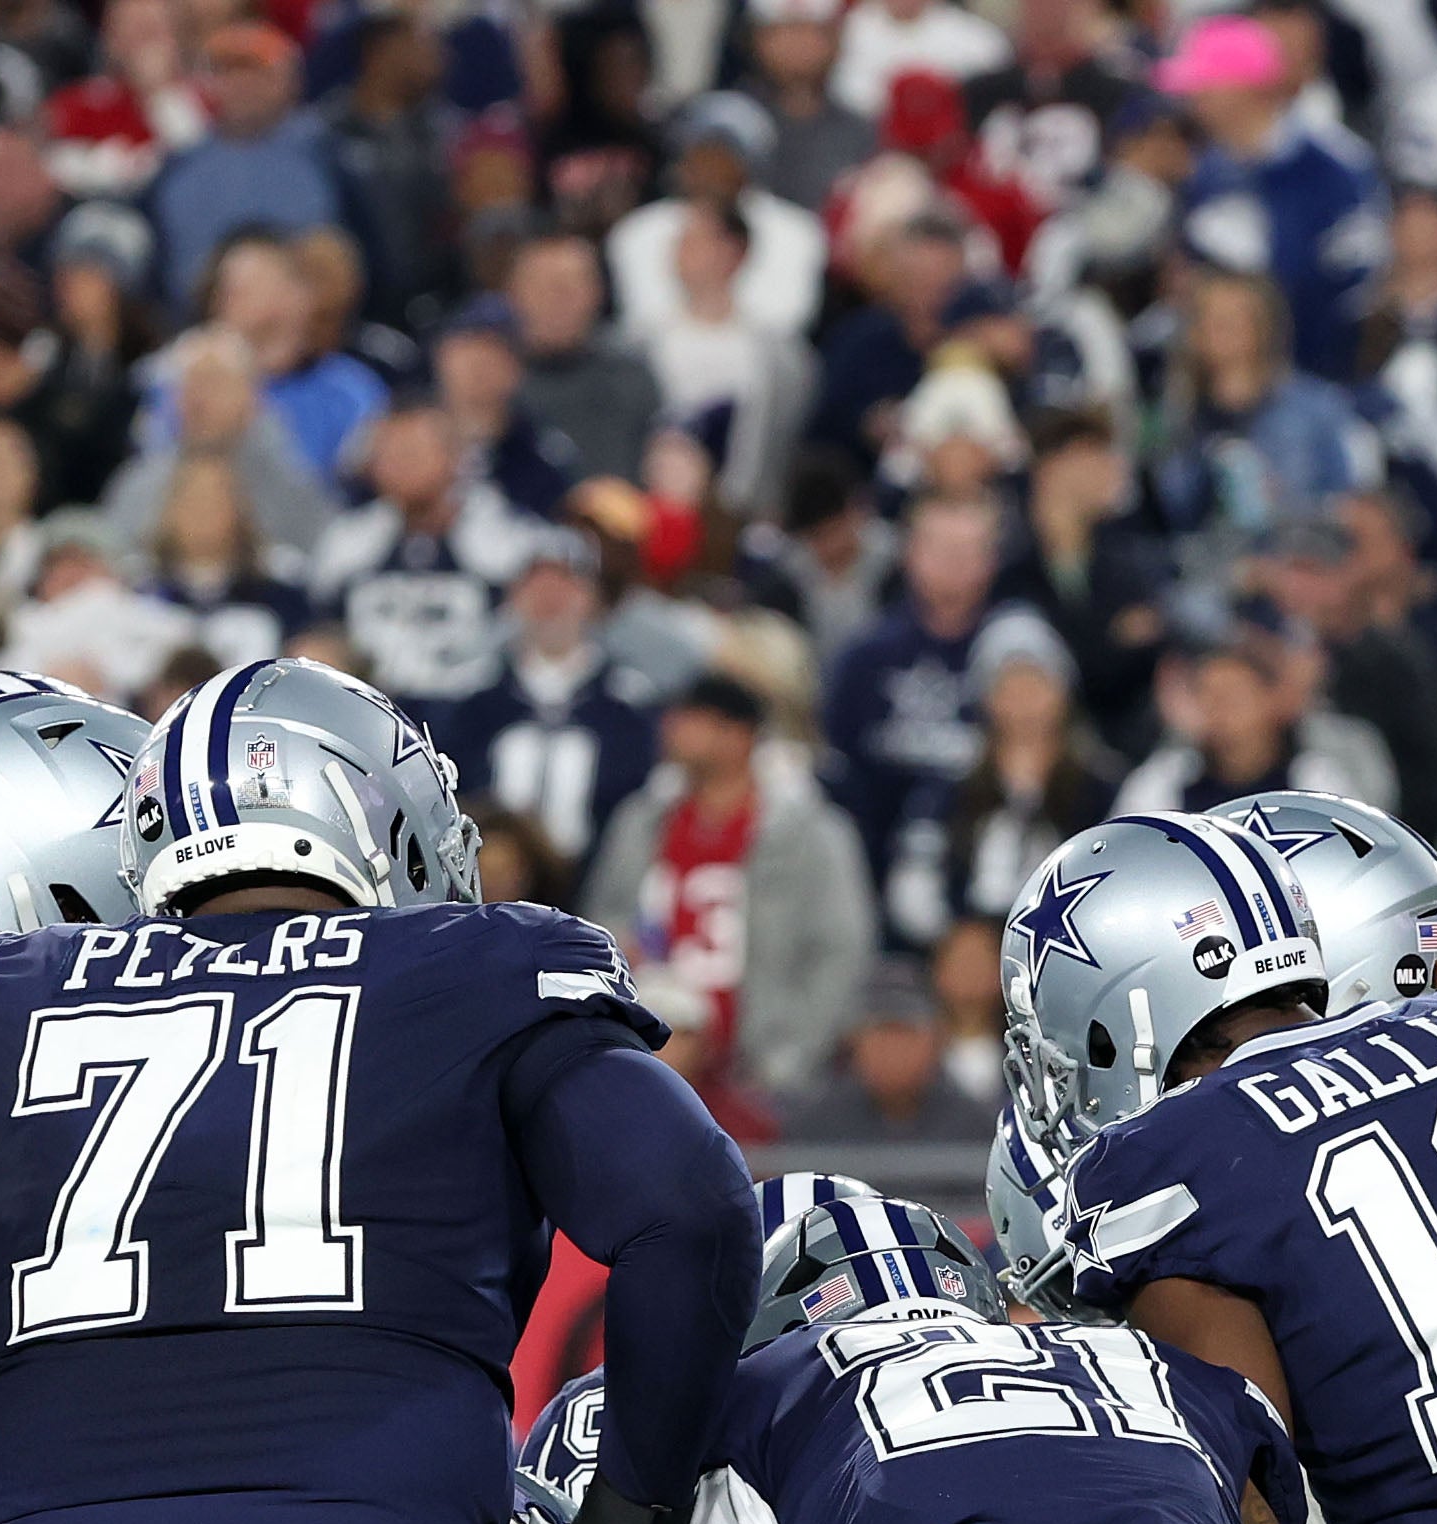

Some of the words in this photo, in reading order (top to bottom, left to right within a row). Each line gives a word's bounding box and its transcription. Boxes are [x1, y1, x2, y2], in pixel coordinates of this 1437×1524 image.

[137, 804, 162, 833] MLK
[176, 847, 193, 864] BE
[195, 836, 236, 857] LOVE
[63, 912, 372, 990] PETERS
[1196, 943, 1236, 972] MLK
[1255, 959, 1274, 975] BE
[1276, 951, 1306, 969] LOVE
[1396, 968, 1426, 985] MLK
[6, 984, 363, 1346] 71
[817, 1318, 1222, 1487] 21
